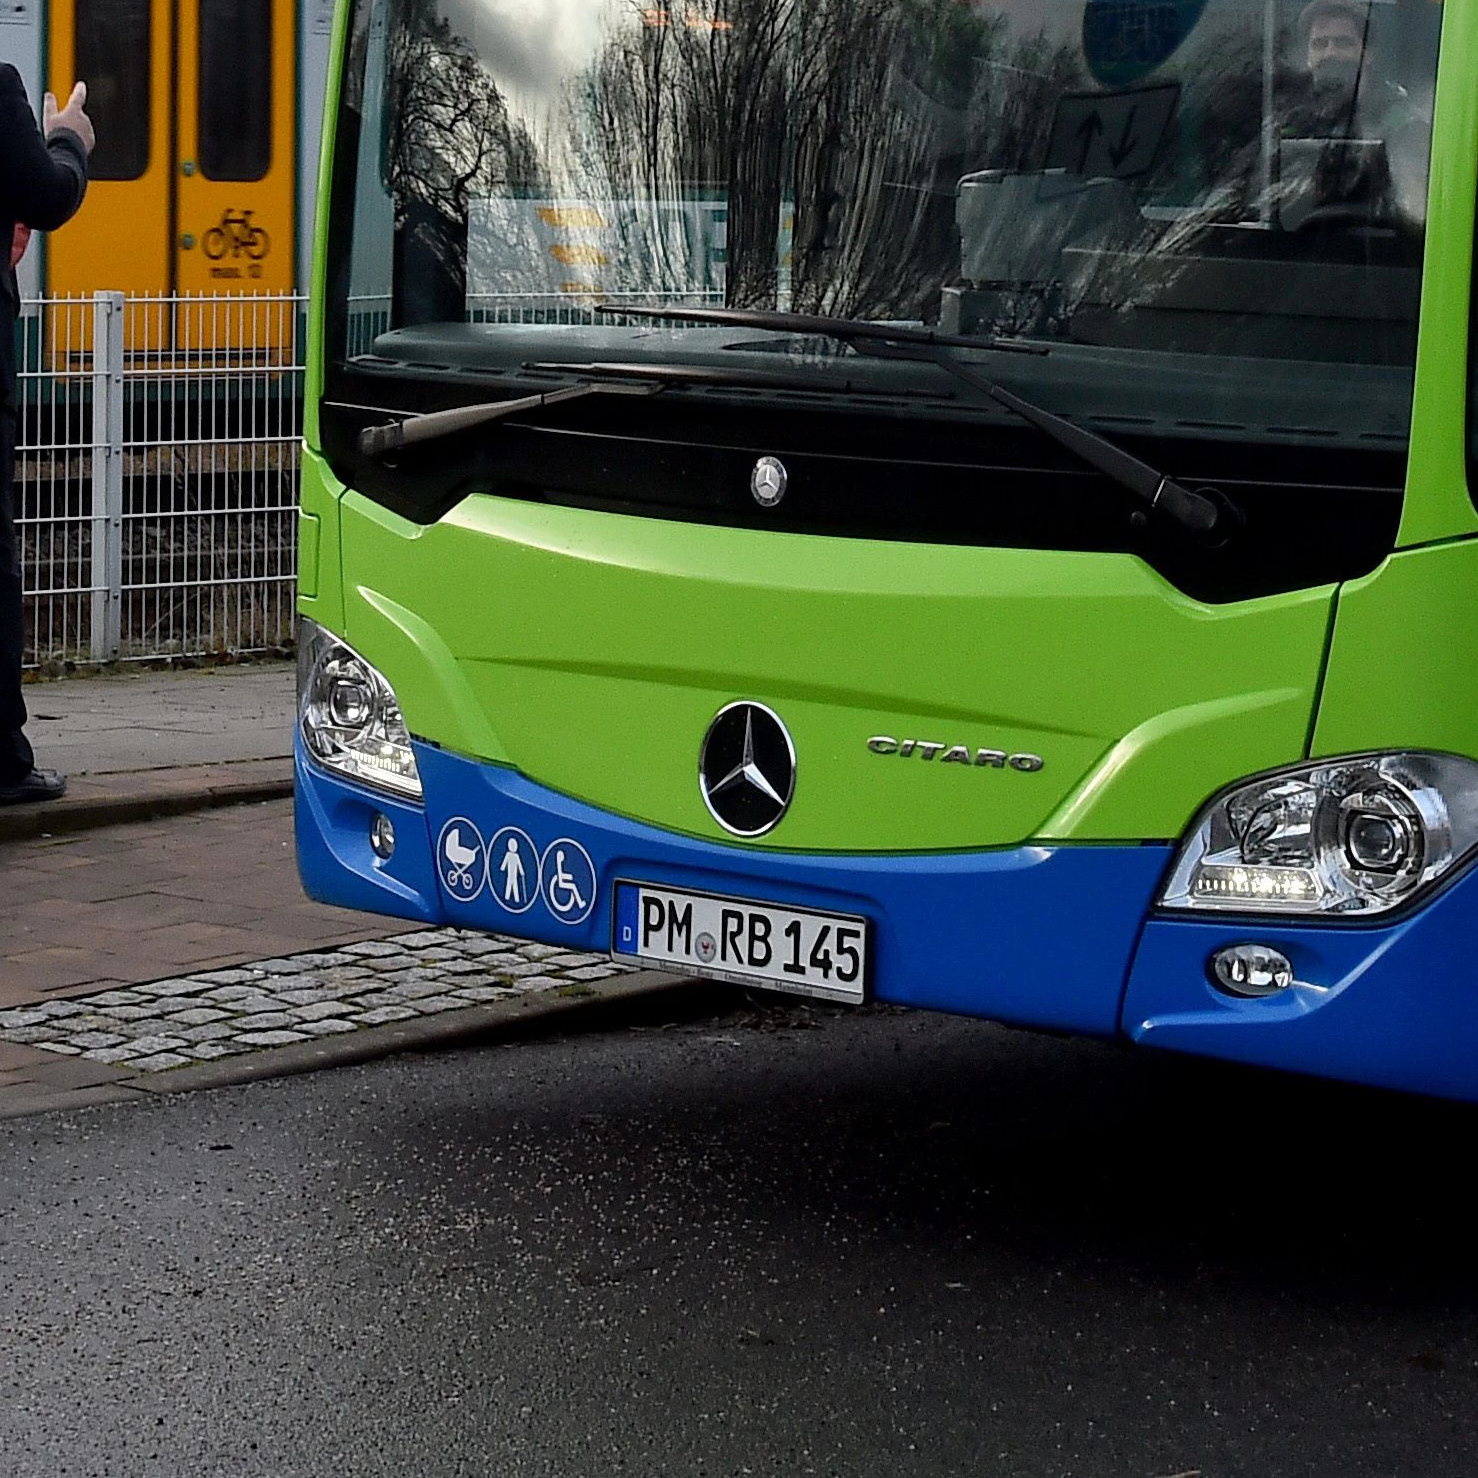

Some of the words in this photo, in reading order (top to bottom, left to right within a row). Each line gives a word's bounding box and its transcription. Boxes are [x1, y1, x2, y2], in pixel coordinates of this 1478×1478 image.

[866, 735, 1045, 772] CITARO
[622, 925, 632, 943] D
[642, 895, 693, 956] PM
[720, 908, 772, 968] RB
[783, 919, 861, 983] 145
